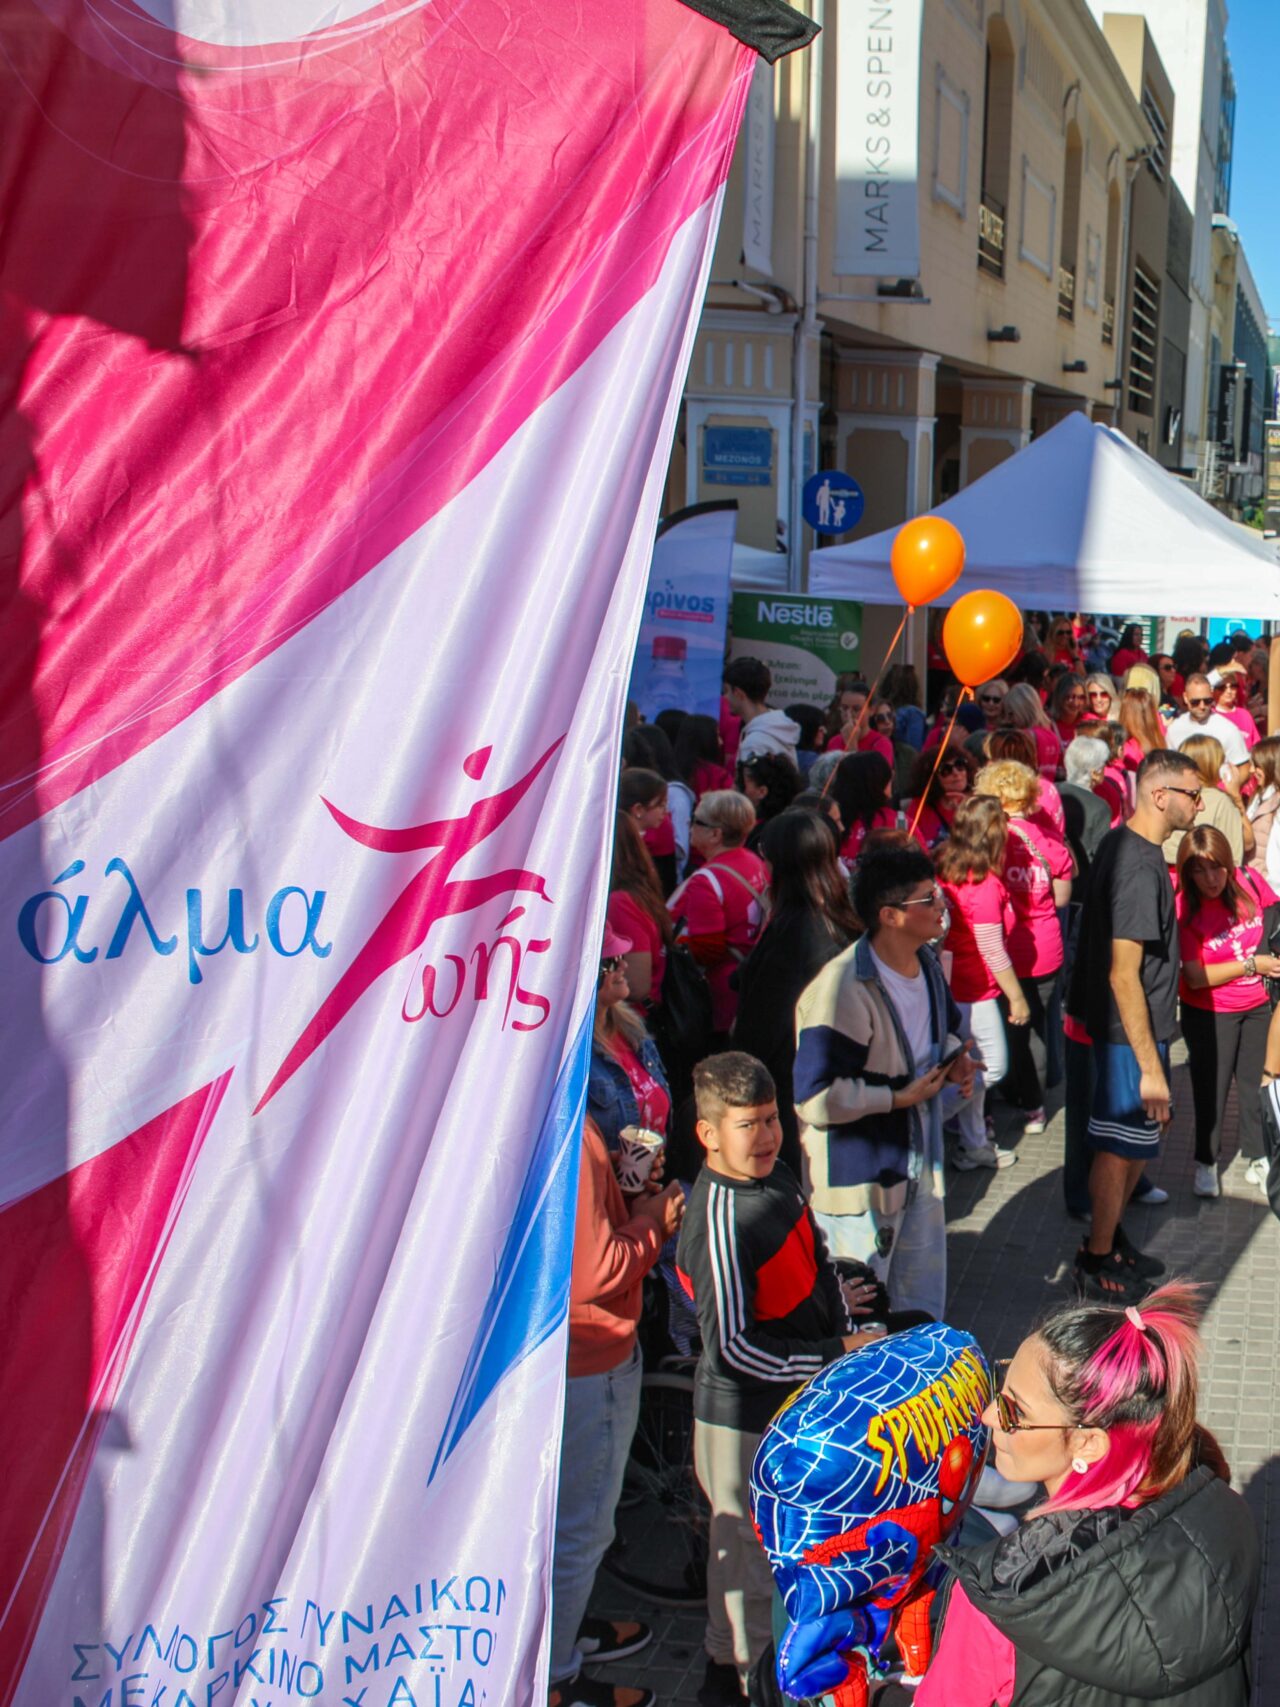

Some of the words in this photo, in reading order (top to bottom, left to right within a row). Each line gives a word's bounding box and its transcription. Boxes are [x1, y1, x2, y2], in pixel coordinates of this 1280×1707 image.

[866, 0, 893, 99] SPEN
[866, 108, 891, 127] &
[864, 136, 891, 252] MARKS
[17, 858, 334, 984] άλμα
[344, 1624, 498, 1685] ΜΑΣΤΟ
